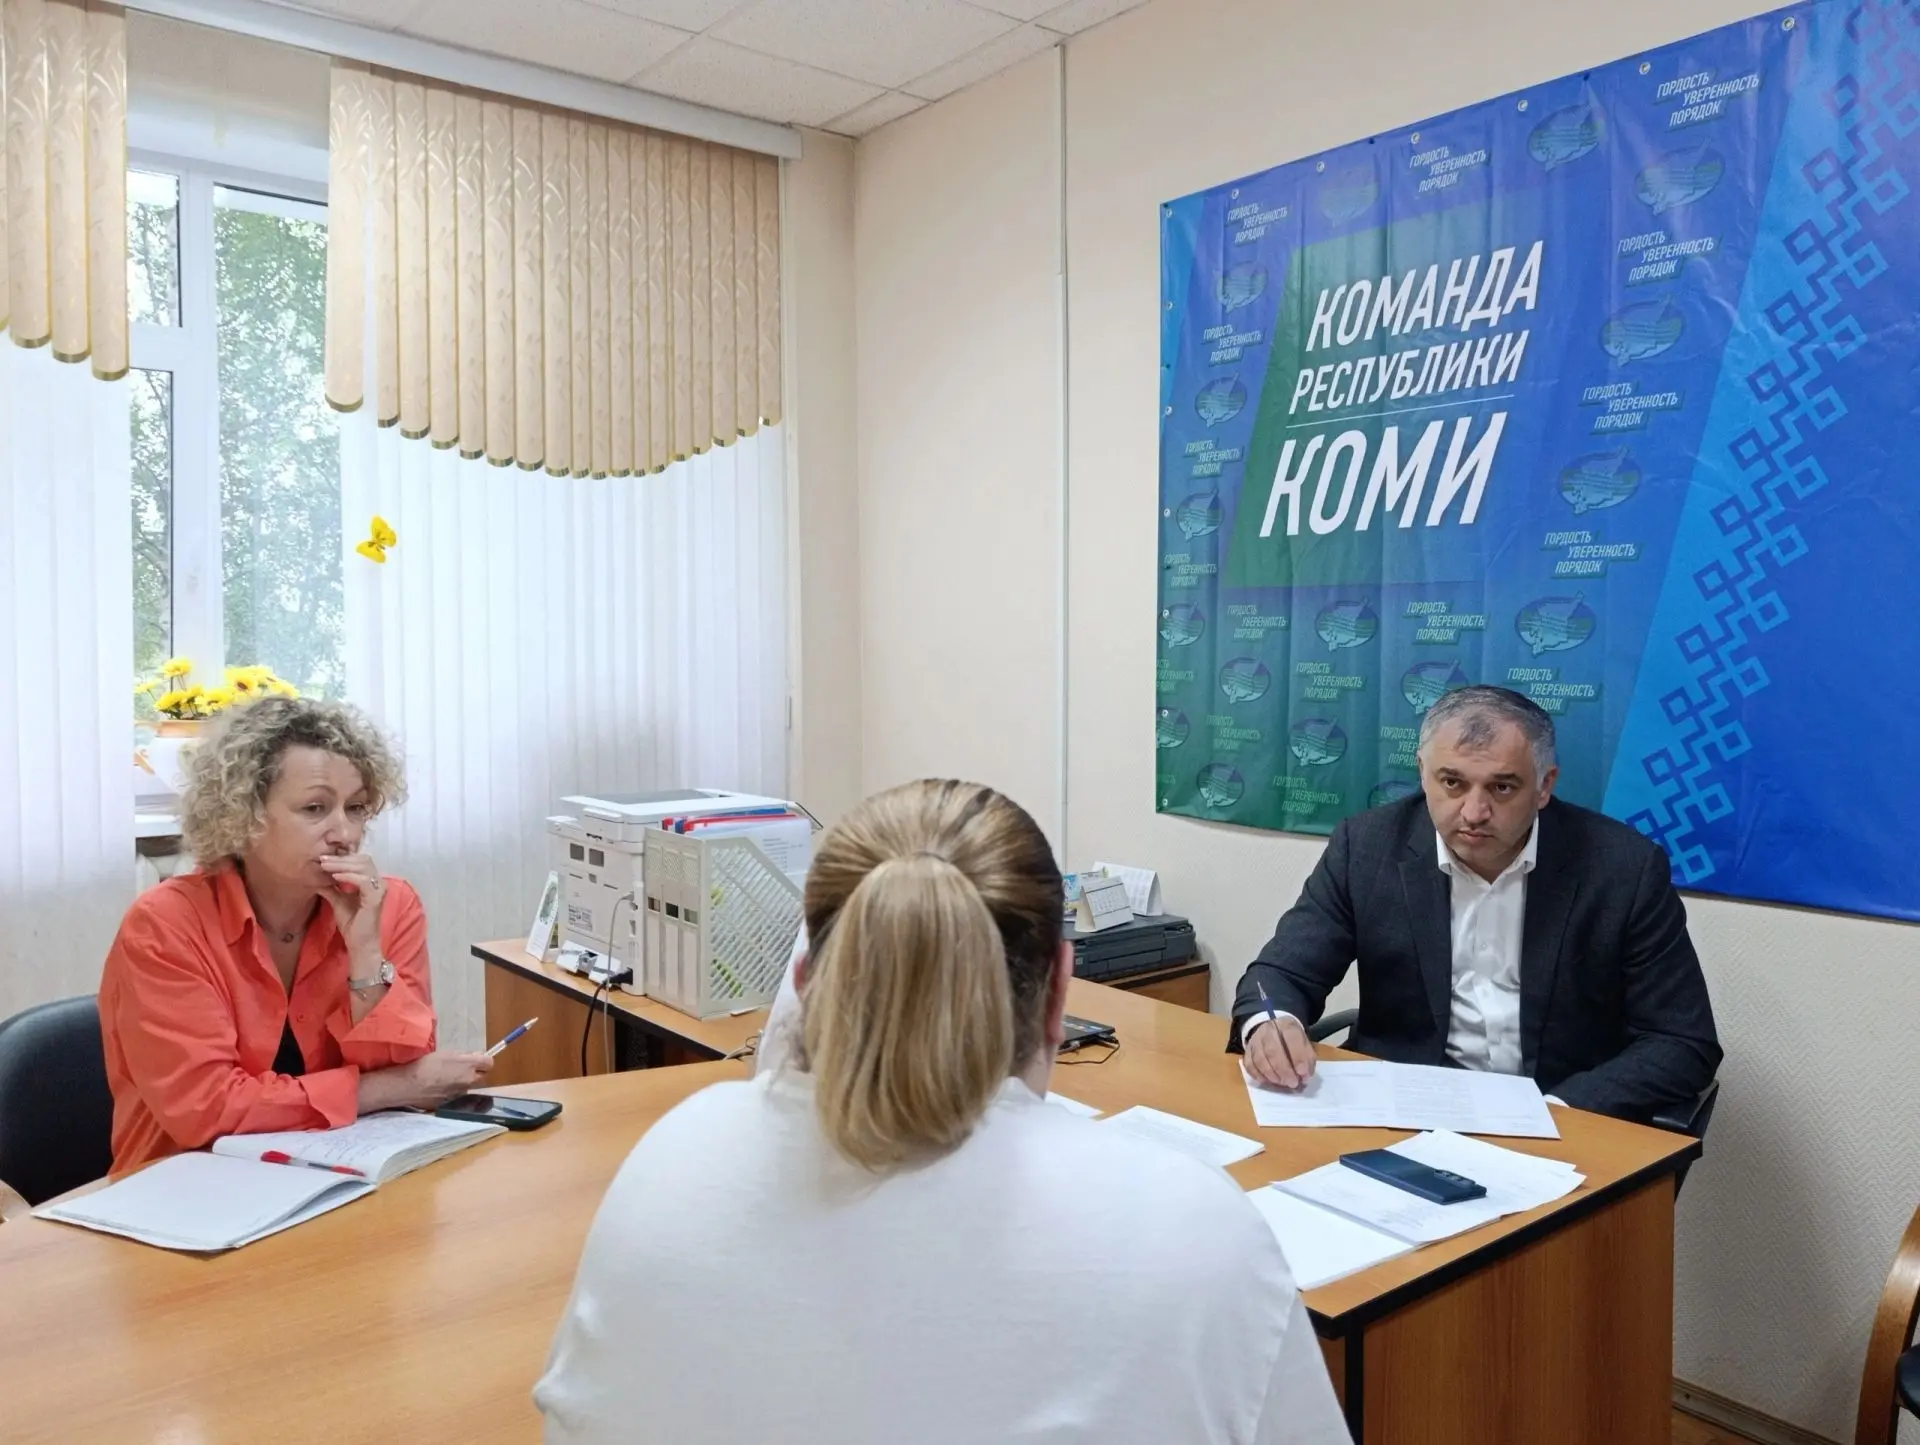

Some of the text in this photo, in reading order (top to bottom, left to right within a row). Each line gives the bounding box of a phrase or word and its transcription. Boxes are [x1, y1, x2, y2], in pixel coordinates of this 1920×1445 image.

[1657, 71, 1709, 98] ГОРДОСТЬ
[1683, 74, 1760, 107] УВЕРЕННОСТЬ
[1669, 99, 1722, 127] ПОРЯДОК
[1409, 146, 1449, 168] ГОРДОСТЬ
[1429, 149, 1486, 176] УВЕРЕННОСТЬ
[1418, 172, 1459, 192] ПОРЯДОК
[1227, 202, 1259, 222] ГОРДОСТЬ
[1243, 206, 1288, 229] УВЕРЕННОСТЬ
[1234, 226, 1266, 244] ПОРЯДОК
[1617, 231, 1666, 254] ГОРДОСТЬ
[1641, 237, 1714, 263] УВЕРЕННОСТЬ
[1628, 259, 1678, 283] ПОРЯДОК
[1305, 240, 1543, 352] КОМАНДА
[1219, 330, 1262, 349] УВЕРЕННОСТЬ
[1288, 329, 1530, 415] РЕСПУБЛИКИ
[1582, 383, 1633, 401] ГОРДОСТЬ
[1608, 392, 1679, 412] УВЕРЕННОСТЬ
[1594, 411, 1644, 429] ПОРЯДОК
[1259, 411, 1508, 538] КОМИ
[1544, 531, 1592, 546] ГОРДОСТЬ
[1568, 543, 1636, 559] УВЕРЕННОСТЬ
[1555, 560, 1604, 574] ПОРЯДОК
[1406, 601, 1447, 615] ГОРДОСТЬ
[1426, 615, 1485, 628] УВЕРЕННОСТЬ
[1415, 628, 1457, 642] ПОРЯДОК
[1295, 661, 1331, 674] ГОРДОСТЬ
[1507, 667, 1553, 682] ГОРДОСТЬ
[1312, 675, 1363, 688] УВЕРЕННОСТЬ
[1529, 683, 1595, 697] УВЕРЕННОСТЬ
[1304, 687, 1339, 700] ПОРЯДОК
[1380, 725, 1417, 740] ГОРДОСТЬ
